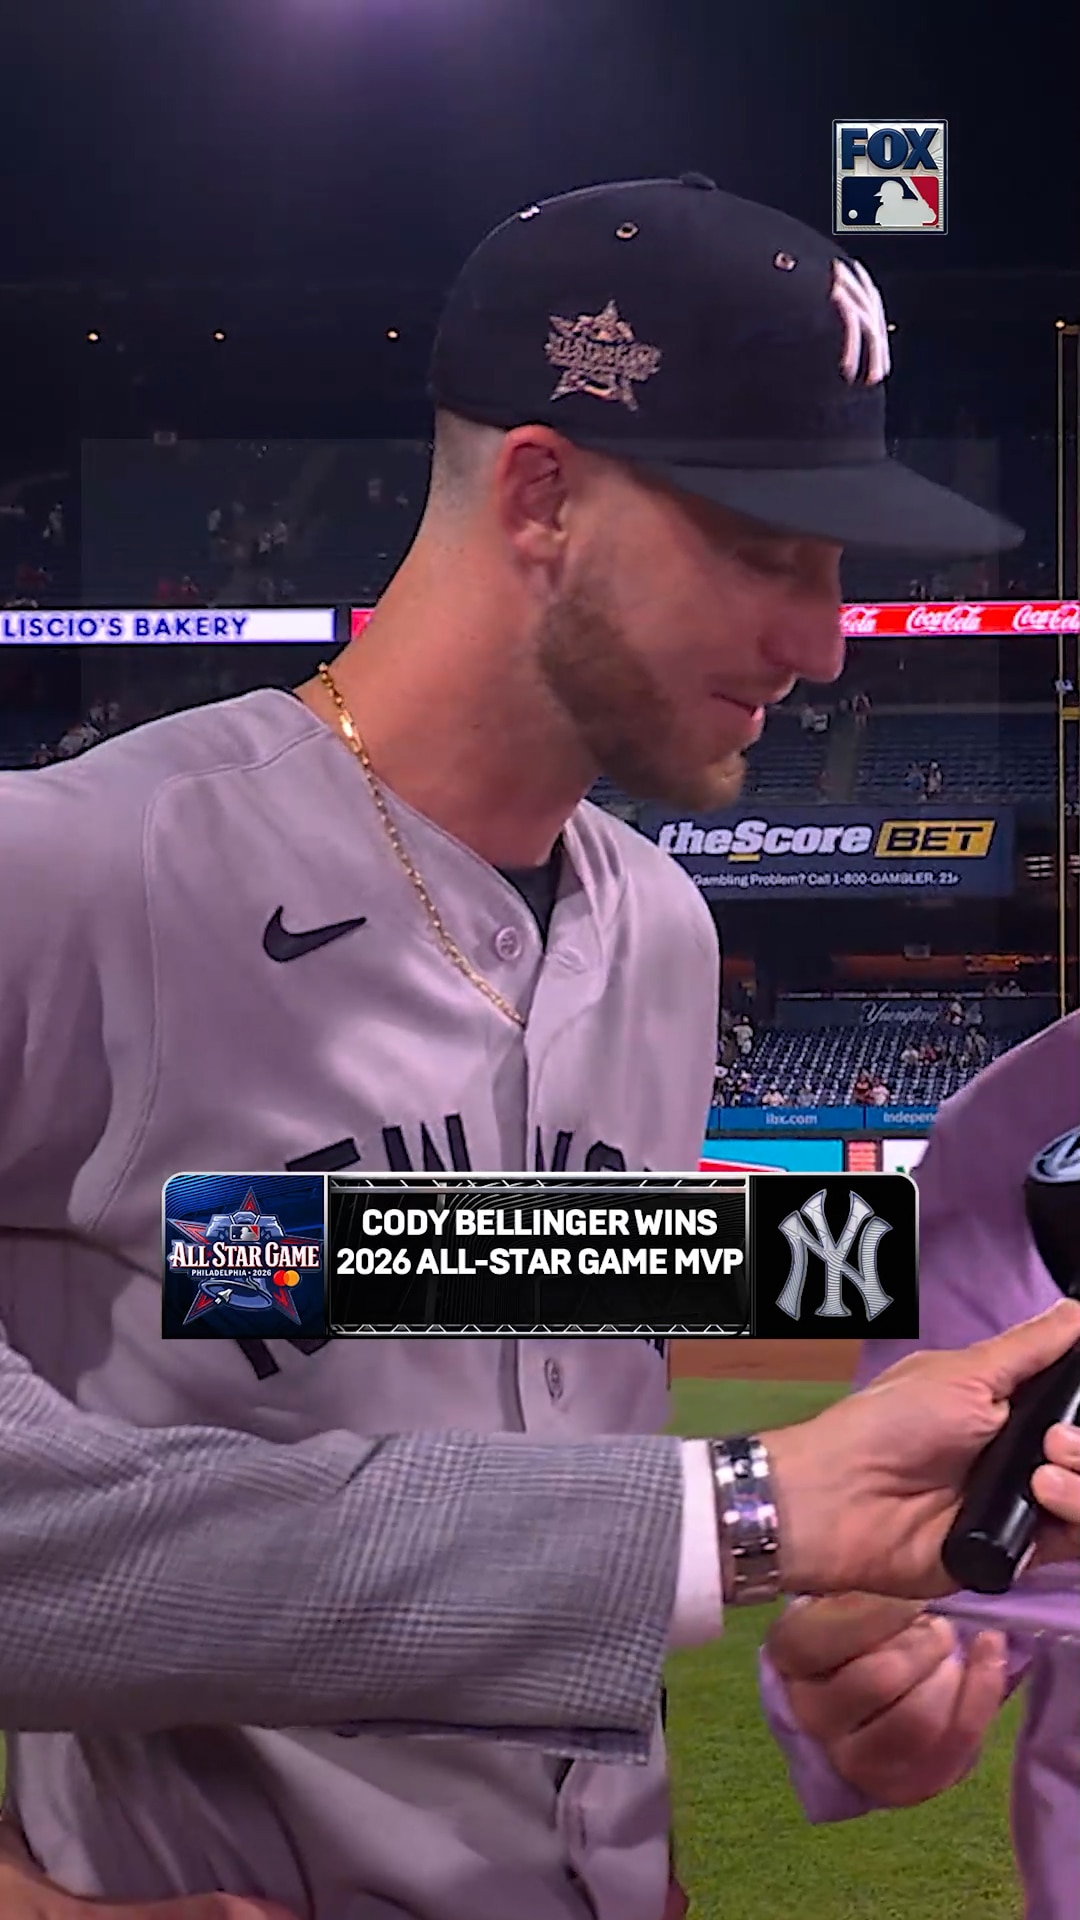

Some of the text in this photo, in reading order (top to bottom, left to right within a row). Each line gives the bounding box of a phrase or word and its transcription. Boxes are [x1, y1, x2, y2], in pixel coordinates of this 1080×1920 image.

[4, 617, 247, 637] LISCIO'S BAKERY
[658, 820, 985, 857] theScore BET
[750, 872, 806, 886] Problem?
[807, 873, 831, 886] Call
[765, 1112, 818, 1125] ibx.com
